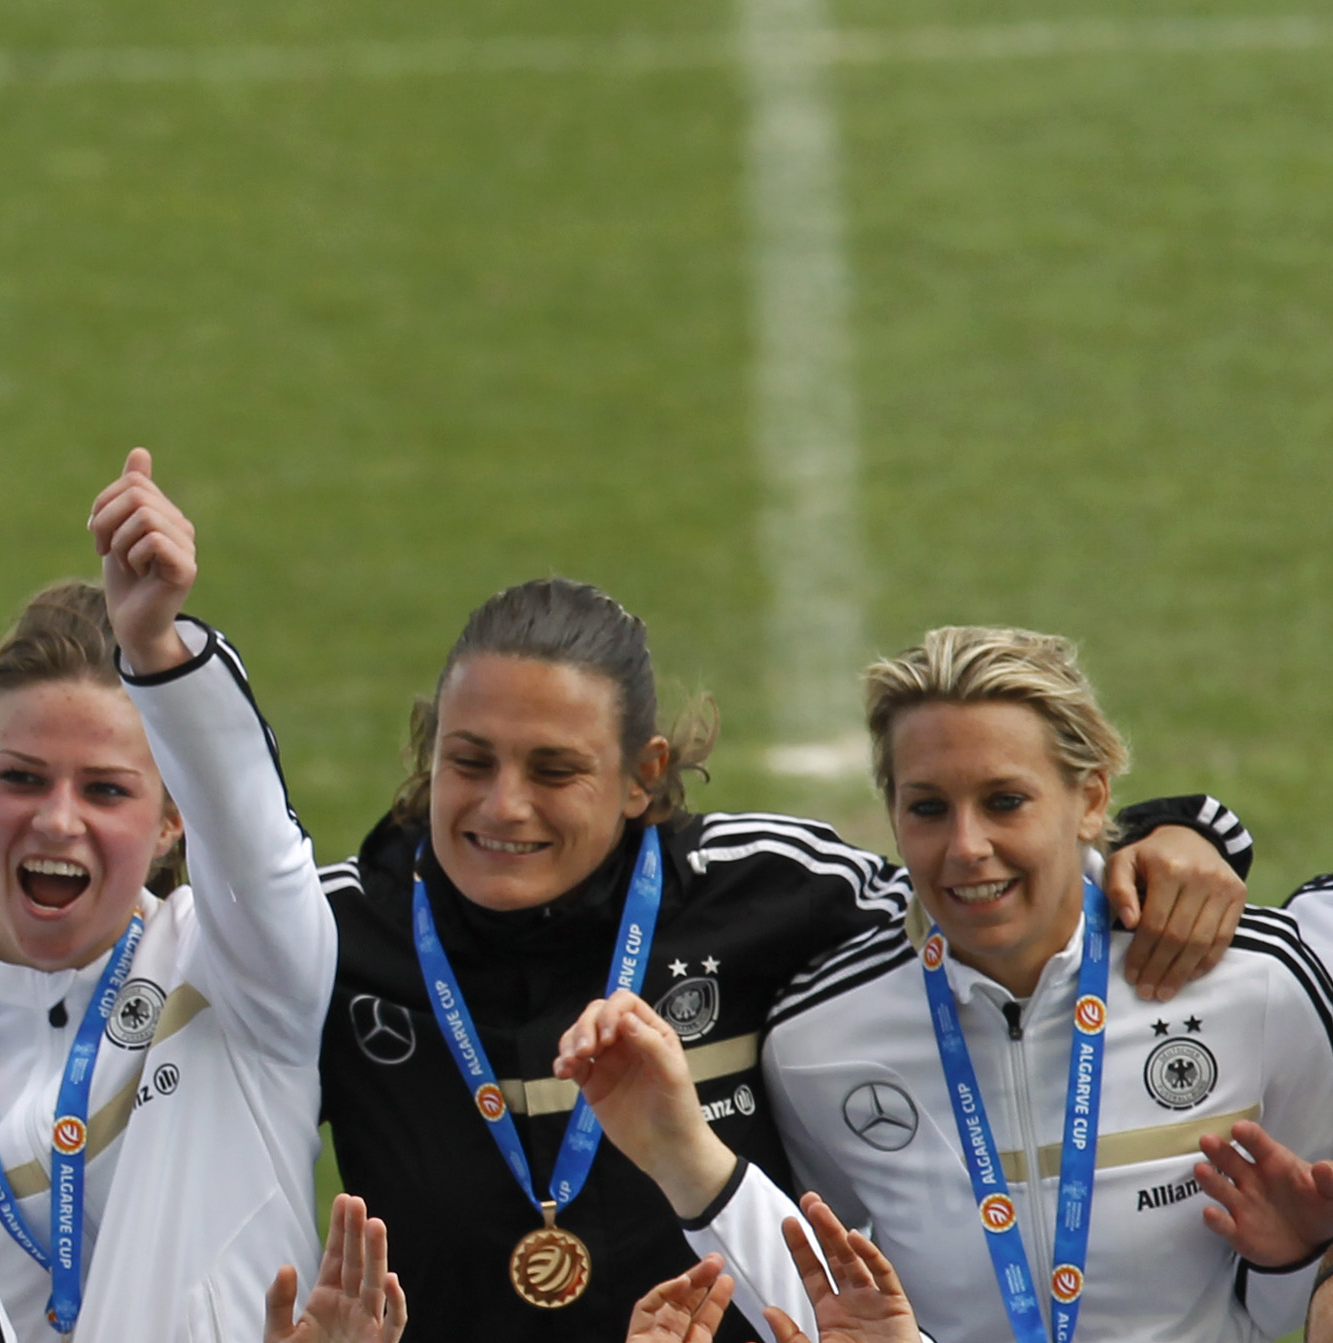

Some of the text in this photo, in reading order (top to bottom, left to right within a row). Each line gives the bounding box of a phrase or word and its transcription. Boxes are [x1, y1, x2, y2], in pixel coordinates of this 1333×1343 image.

[100, 922, 143, 1019] ALGARVE CUP
[625, 923, 643, 956] CUP
[435, 979, 483, 1076] ALGARVE CUP
[958, 1083, 997, 1185] ALGARVE CUP
[1072, 1042, 1094, 1150] ALGARVE CUP
[58, 1164, 74, 1270] ALGARVE CUP
[1137, 1179, 1202, 1212] Allian
